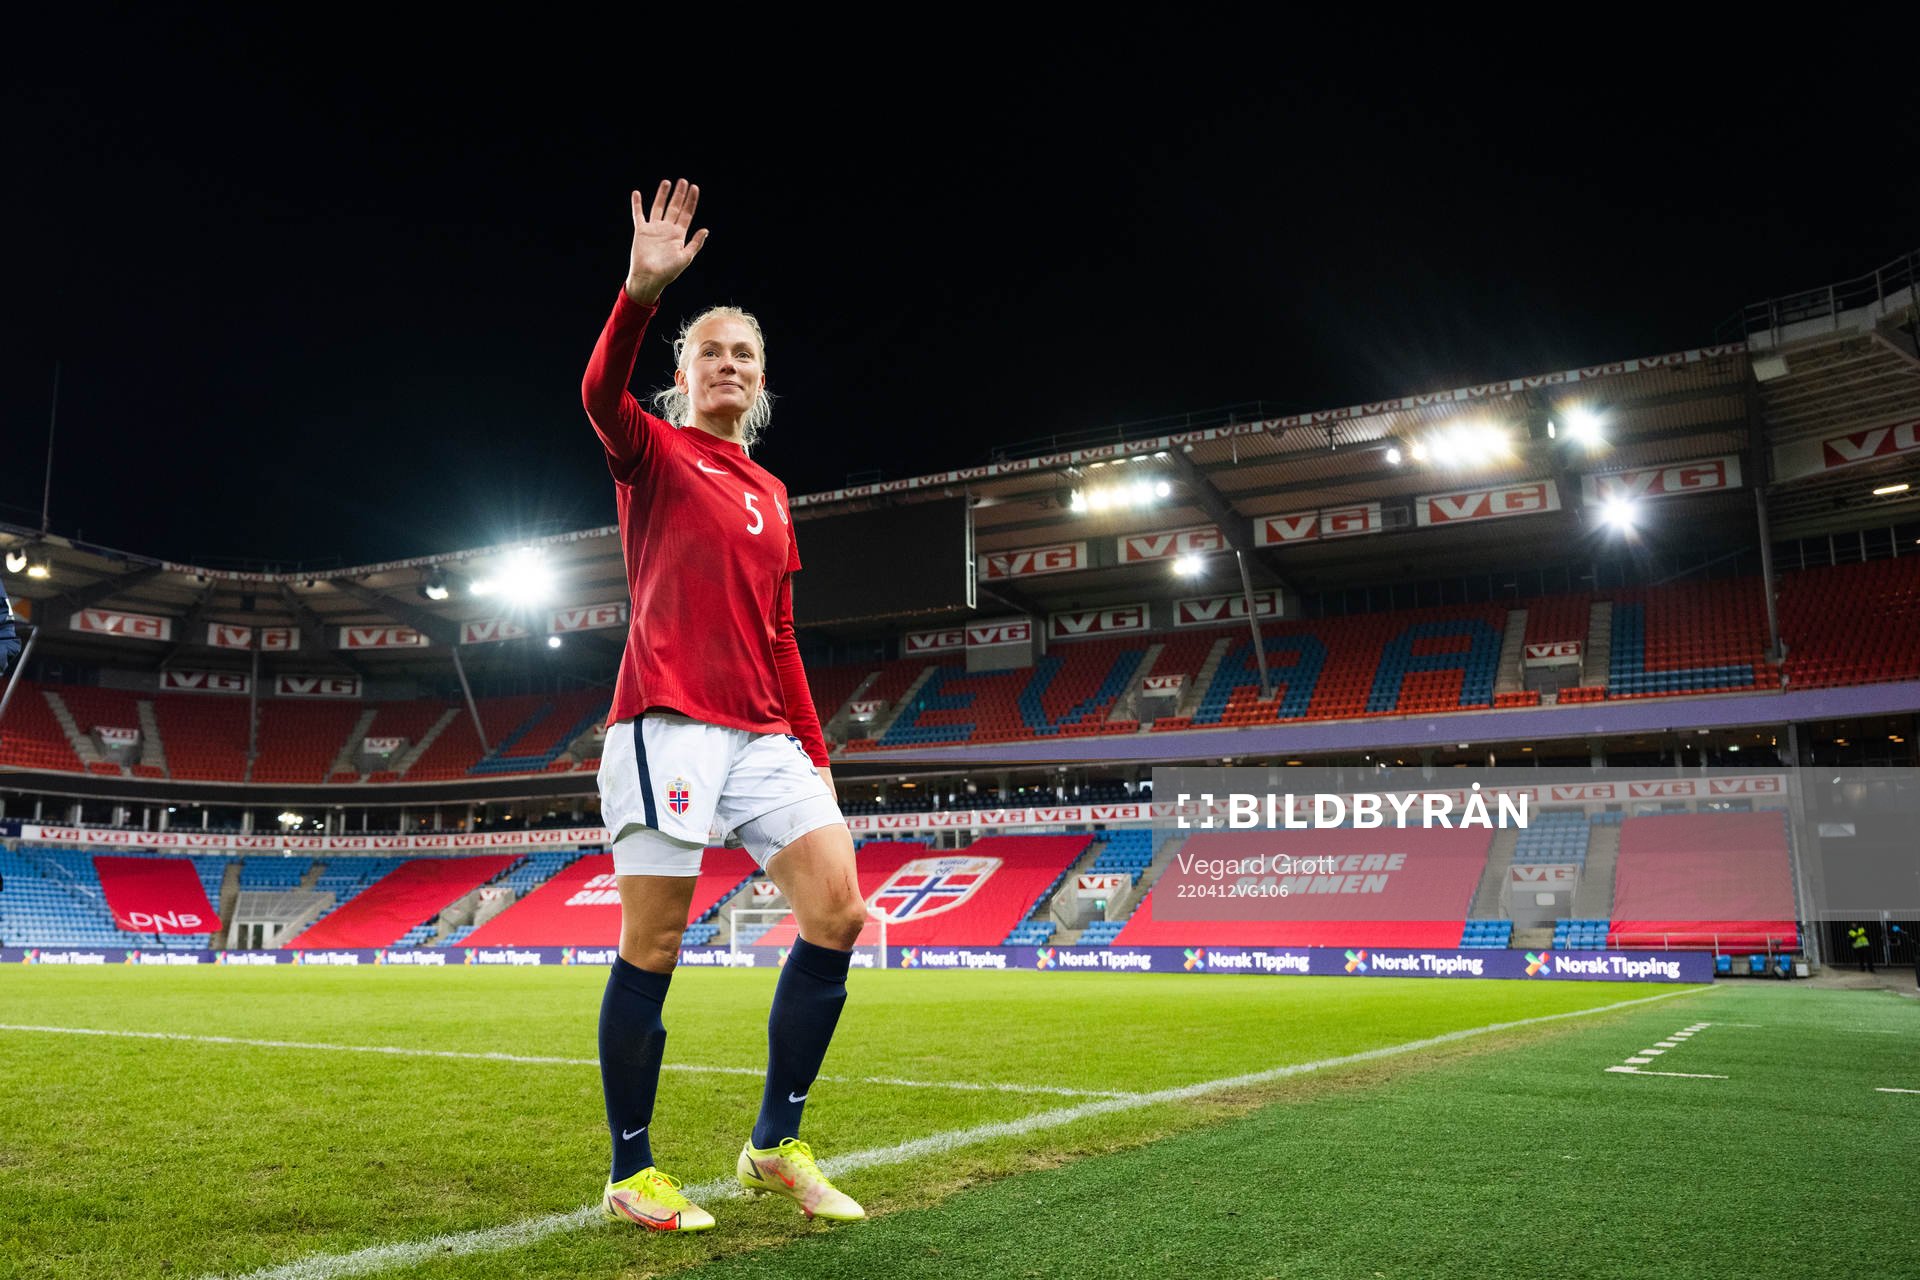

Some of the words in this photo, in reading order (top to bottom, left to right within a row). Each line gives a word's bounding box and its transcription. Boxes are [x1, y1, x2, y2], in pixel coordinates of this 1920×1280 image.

[744, 491, 764, 535] 5
[1431, 486, 1542, 522] VG
[1267, 508, 1366, 542] VG
[1128, 530, 1221, 560] VG
[990, 546, 1073, 576] VG
[1180, 593, 1275, 622] VG
[81, 612, 160, 637] VG
[554, 607, 616, 631] VG
[1054, 607, 1140, 635] VG
[219, 627, 289, 648] VG
[350, 628, 420, 646] VG
[909, 632, 963, 650] VG
[969, 623, 1028, 644] VG
[1527, 642, 1580, 658] VG
[168, 672, 241, 690] VG
[285, 678, 353, 695] VG
[1143, 677, 1183, 691] VG
[878, 816, 919, 828] VG
[929, 814, 971, 827] VG
[981, 811, 1025, 824] VG
[1035, 809, 1081, 822] VG
[1092, 806, 1139, 820] VG
[1552, 784, 1614, 800] VG
[1629, 780, 1695, 797] VG
[1709, 777, 1779, 795] VG
[41, 829, 79, 840] VG
[88, 832, 128, 843] VG
[137, 834, 178, 845] VG
[187, 836, 227, 846] VG
[236, 836, 275, 847] VG
[283, 836, 322, 847] VG
[330, 837, 367, 848] VG
[374, 838, 408, 848] VG
[415, 837, 448, 847] VG
[454, 835, 485, 846] VG
[491, 833, 522, 844] VG
[528, 831, 561, 843] VG
[568, 830, 600, 842] VG
[1512, 866, 1576, 882] VG
[129, 911, 202, 931] DNB
[921, 951, 960, 967] Norsk
[960, 951, 1007, 970] Tipping
[1059, 952, 1101, 968] Norsk
[1101, 952, 1152, 970] Tipping
[1208, 952, 1252, 969] Norsk
[1252, 952, 1310, 973] Tipping
[1371, 953, 1420, 971] Norsk
[1420, 953, 1484, 975] Tipping
[1555, 956, 1609, 974] Norsk
[1609, 956, 1681, 979] Tipping
